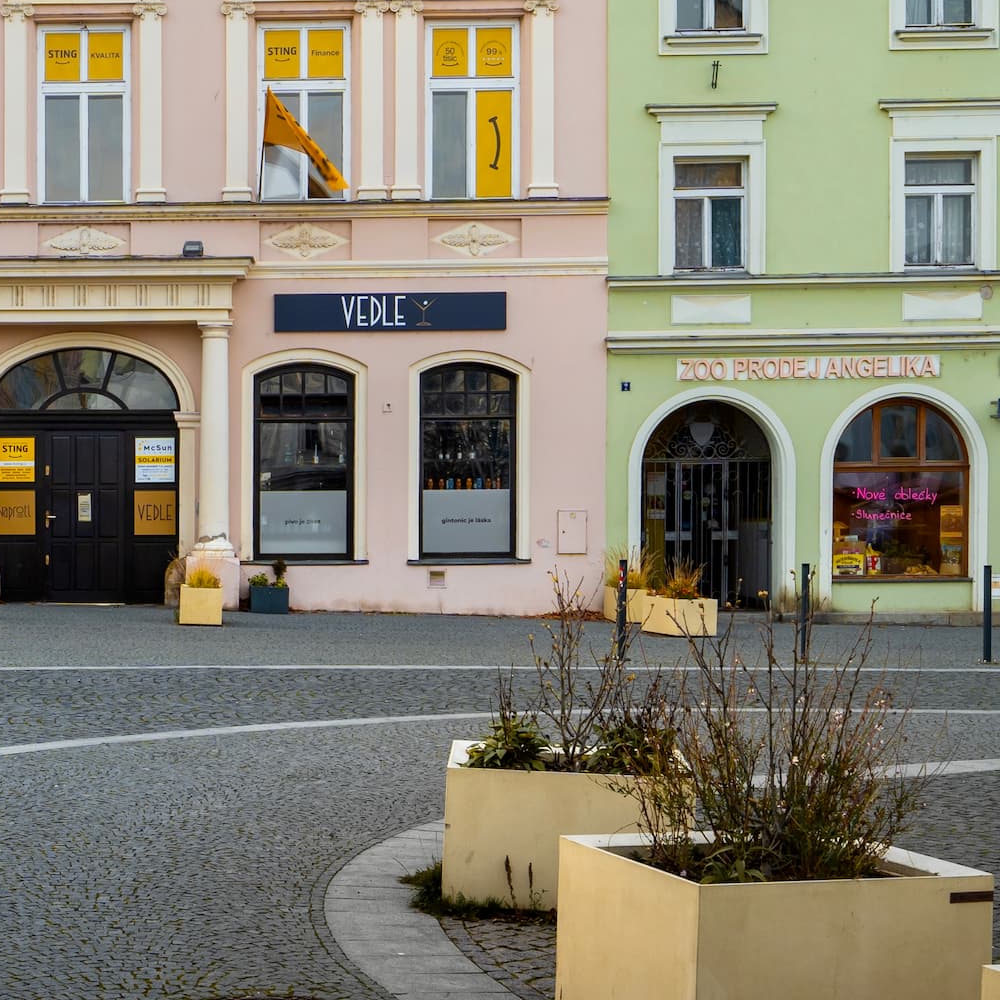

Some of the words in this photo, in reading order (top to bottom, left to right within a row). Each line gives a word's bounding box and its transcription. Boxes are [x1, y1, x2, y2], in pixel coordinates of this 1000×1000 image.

[48, 49, 77, 59] STING
[267, 47, 297, 56] STING
[311, 49, 340, 57] Finance
[341, 295, 406, 329] VEDLE
[680, 359, 728, 381] ZOO
[733, 357, 821, 380] PRODEJ
[824, 355, 937, 379] ANGELIKA
[2, 445, 28, 453] STING
[856, 487, 887, 500] Nové
[137, 503, 173, 521] VEDLE
